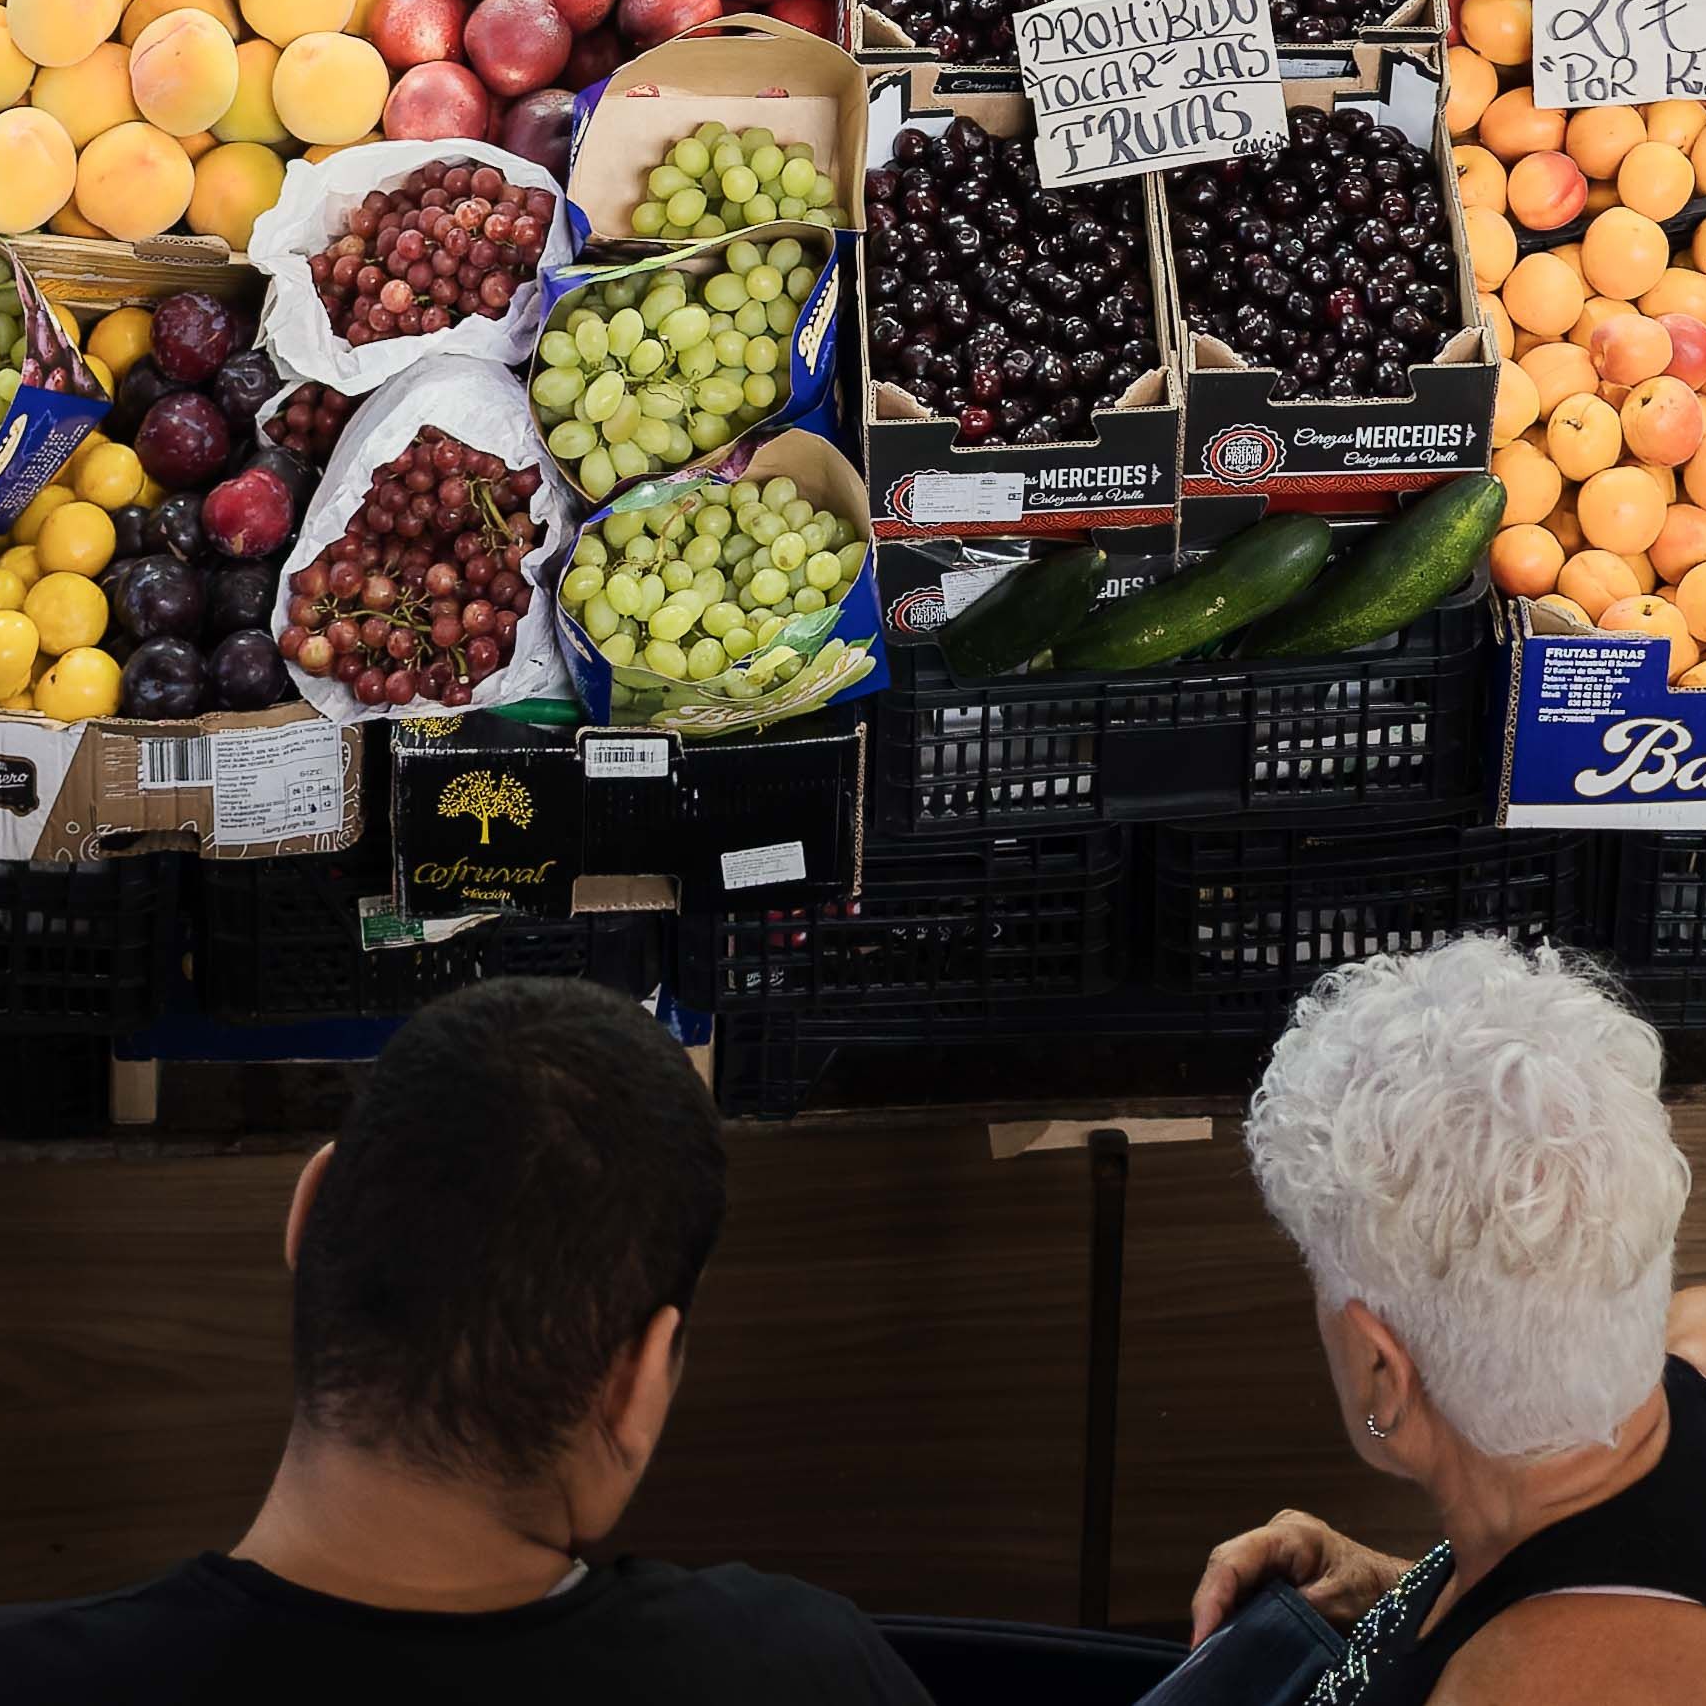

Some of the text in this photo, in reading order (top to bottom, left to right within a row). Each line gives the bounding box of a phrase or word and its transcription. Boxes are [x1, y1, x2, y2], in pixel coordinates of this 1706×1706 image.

[1182, 33, 1271, 89] LAS
[1049, 90, 1253, 173] FRUTAS
[1355, 423, 1462, 450] MERCEDES
[1039, 463, 1148, 491] MERCEDES
[1545, 647, 1646, 659] FRUTAS BARAS
